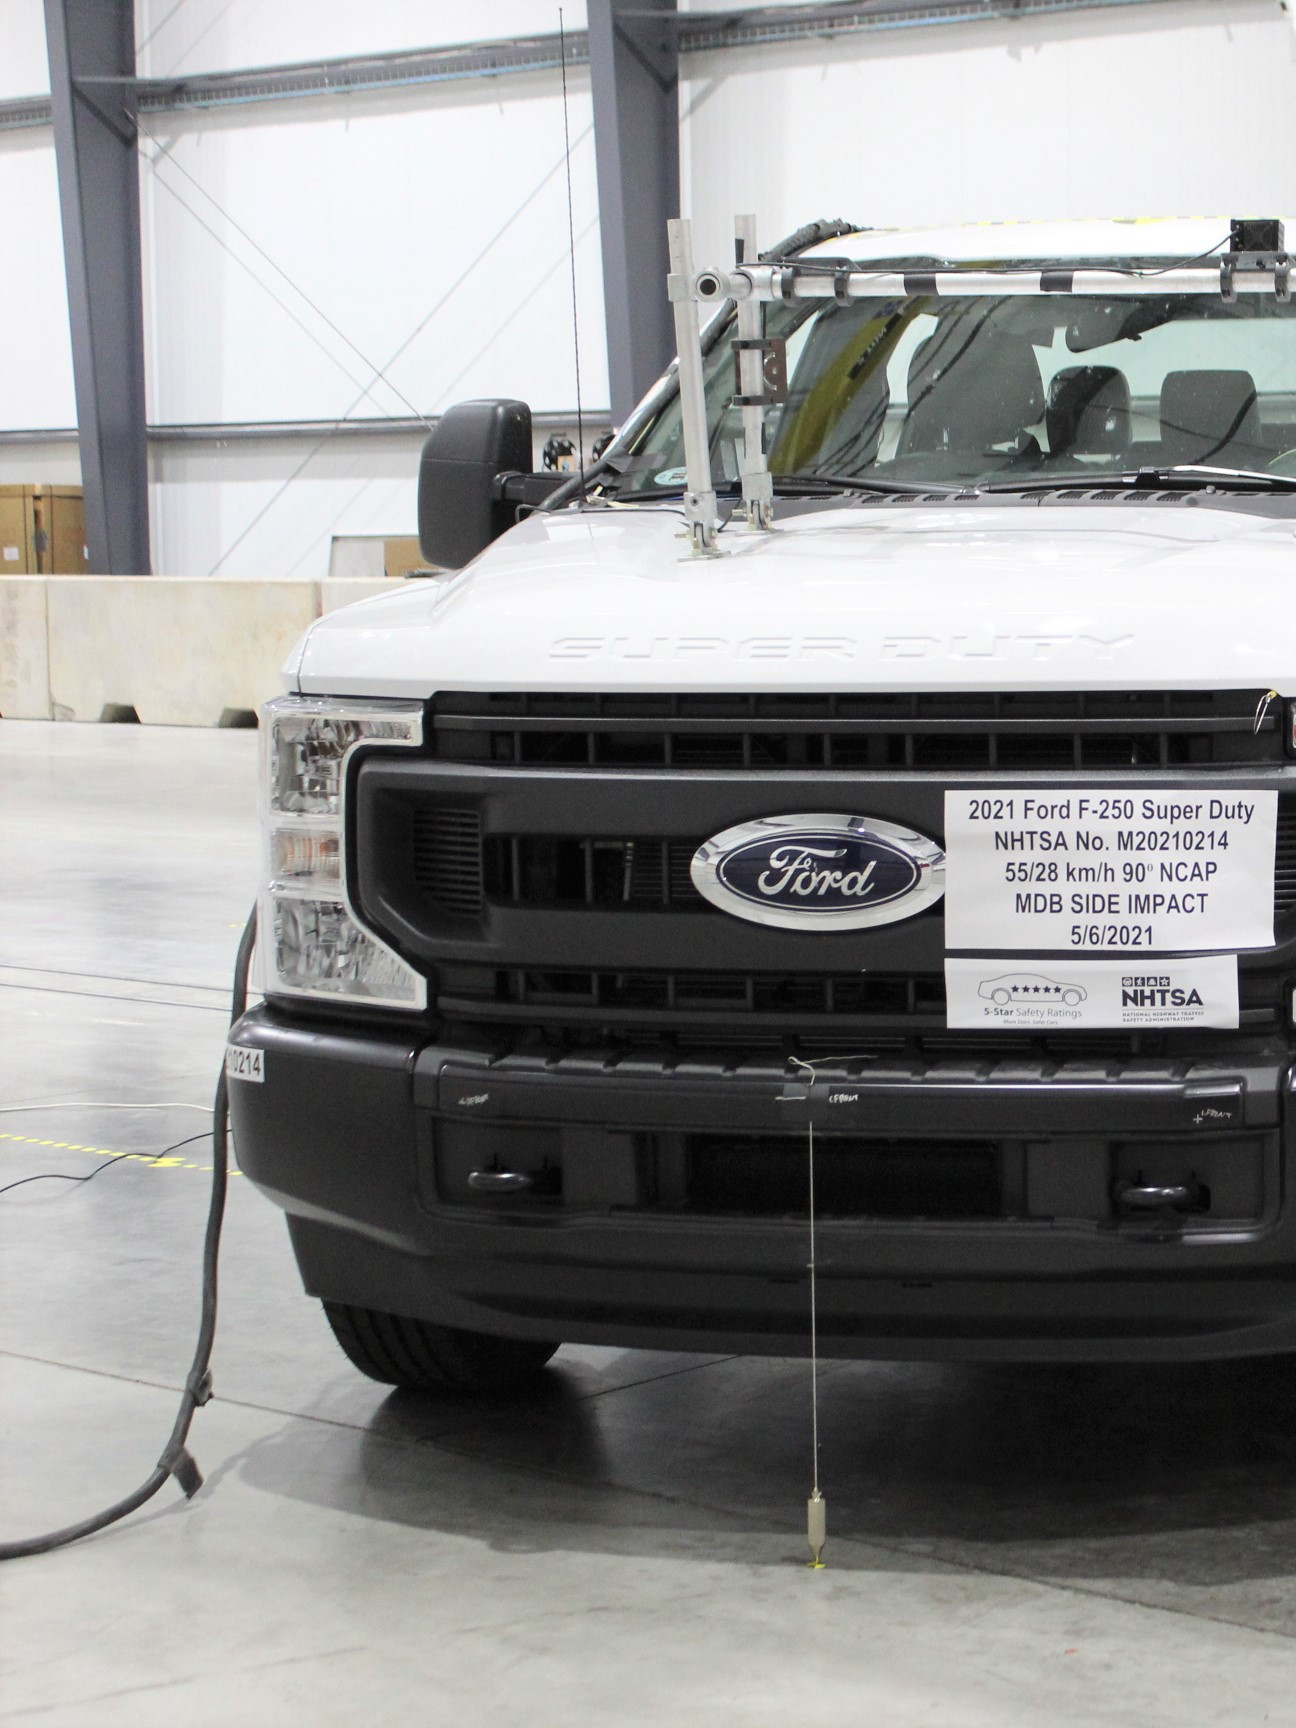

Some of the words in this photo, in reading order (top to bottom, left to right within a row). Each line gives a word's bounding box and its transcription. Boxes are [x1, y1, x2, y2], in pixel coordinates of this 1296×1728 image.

[548, 636, 857, 663] SUPER
[876, 634, 1137, 662] DUTY
[968, 799, 1015, 820] 2021
[1023, 799, 1071, 820] Ford
[1078, 799, 1135, 820] F-250
[1141, 799, 1203, 825] Super
[1209, 799, 1256, 825] Duty
[994, 830, 1069, 851] NHTSA
[1076, 830, 1109, 851] No.
[1117, 830, 1230, 851] M20210214
[758, 845, 877, 896] Ford
[1005, 861, 1059, 883] 55/28
[1066, 861, 1115, 883] km/h
[1160, 861, 1218, 883] NCAP
[1015, 893, 1063, 914] MDB
[1070, 893, 1121, 914] SIDE
[1128, 893, 1209, 914] IMPACT
[1071, 925, 1153, 946] 5/6/2021
[1121, 988, 1204, 1007] NHTSA
[984, 1007, 1014, 1016] 5-Star
[1016, 1007, 1046, 1019] Safety
[1047, 1008, 1082, 1019] Ratings
